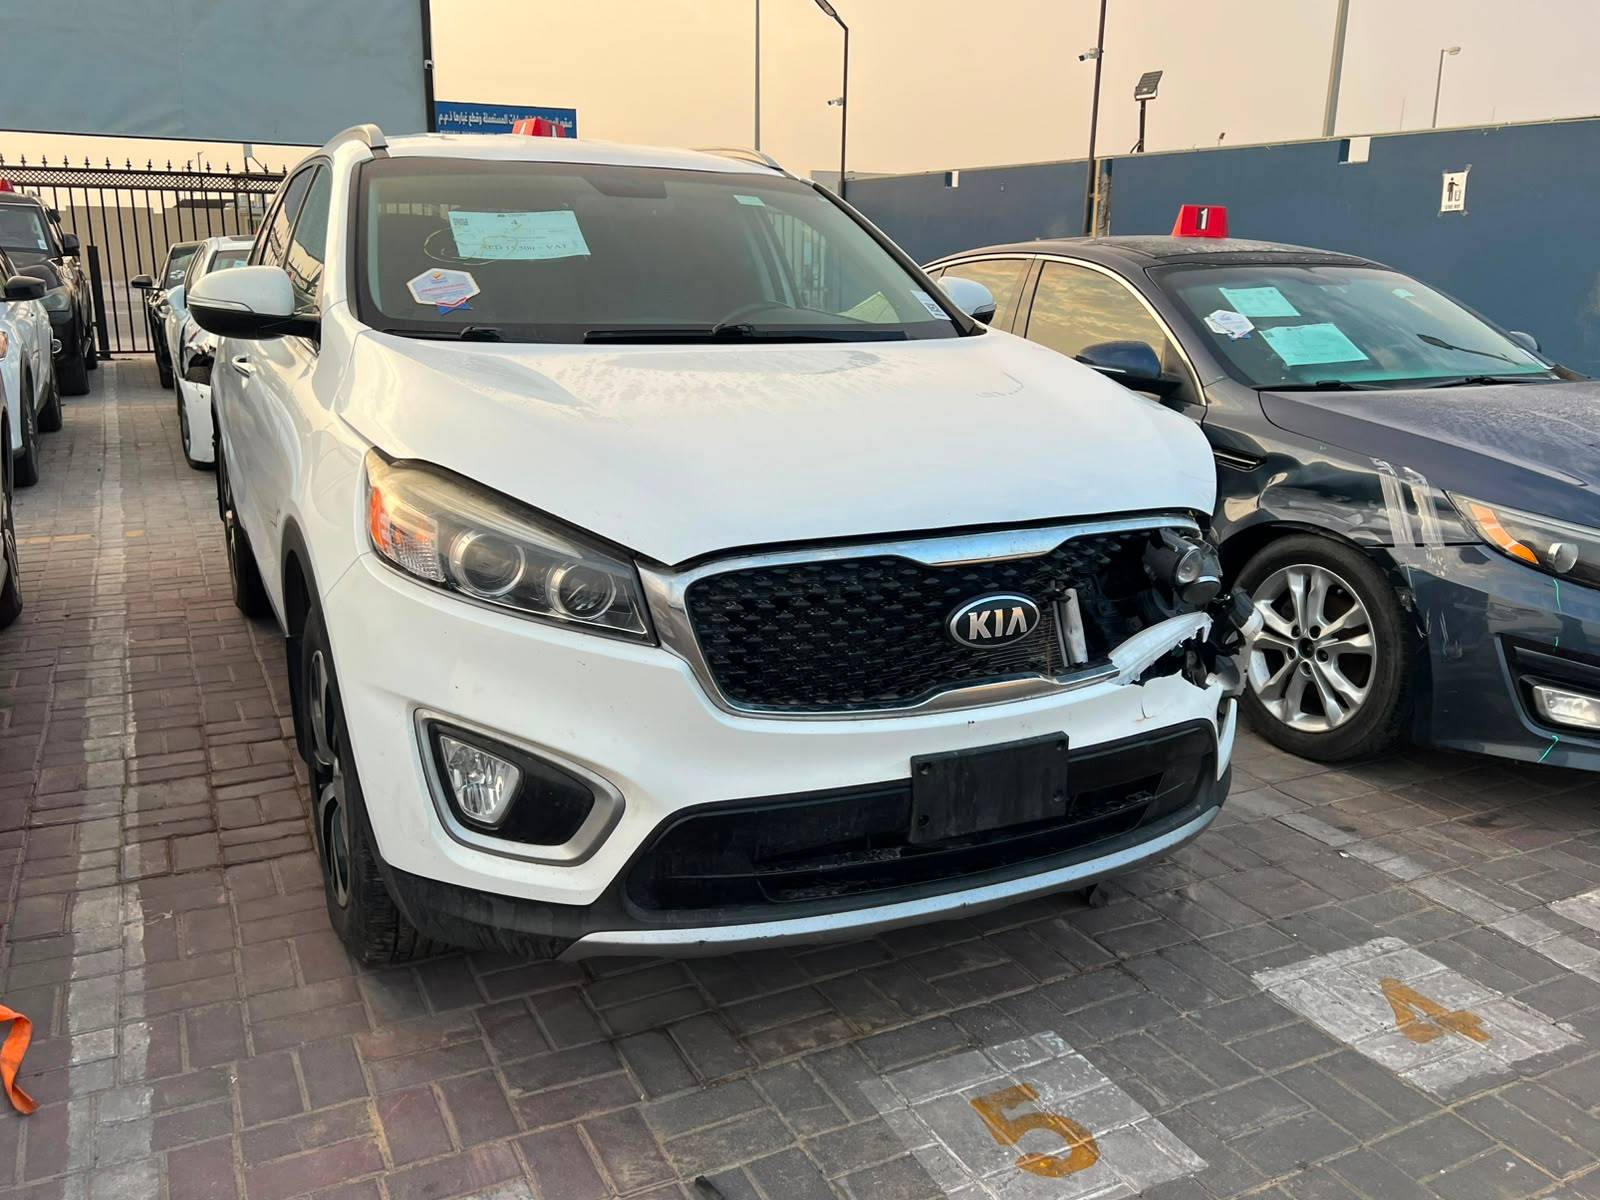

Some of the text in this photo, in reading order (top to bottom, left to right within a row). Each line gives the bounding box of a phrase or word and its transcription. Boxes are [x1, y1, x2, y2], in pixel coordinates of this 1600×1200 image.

[1200, 207, 1209, 230] 1
[968, 606, 1028, 640] KIA
[1380, 976, 1493, 1044] 4
[969, 1082, 1101, 1180] 5
